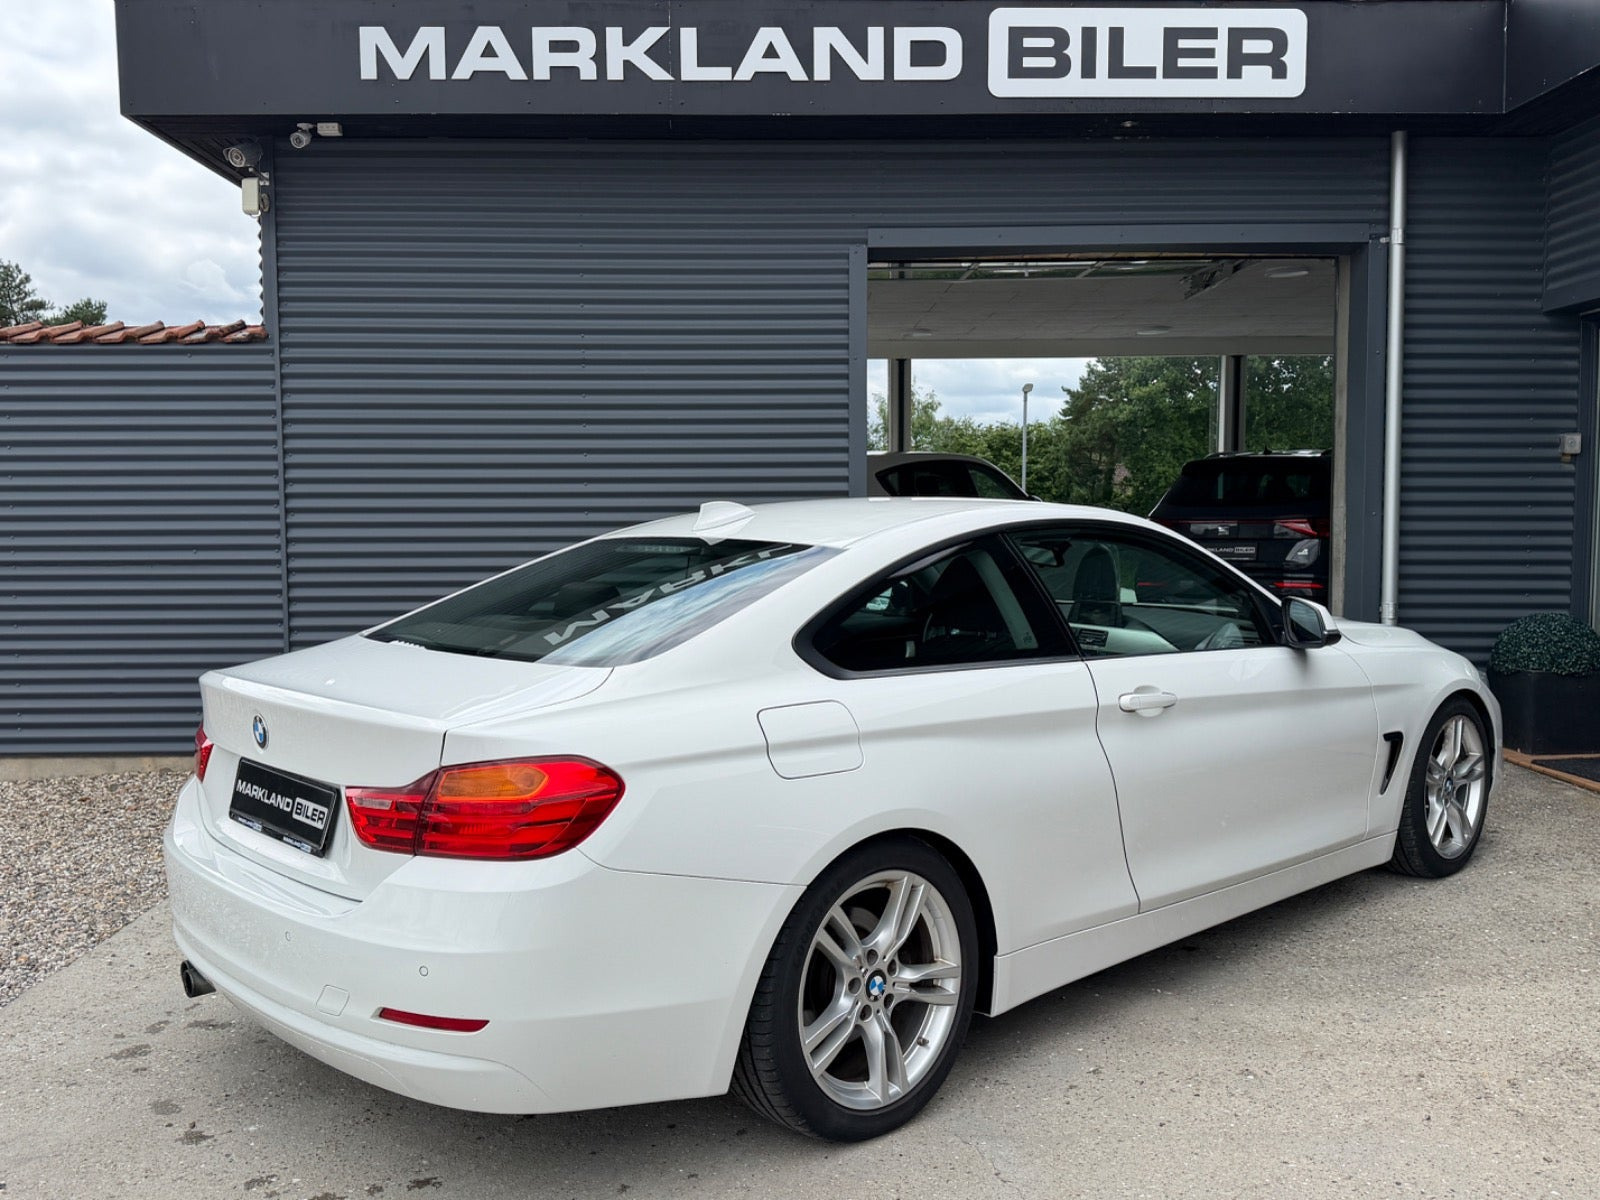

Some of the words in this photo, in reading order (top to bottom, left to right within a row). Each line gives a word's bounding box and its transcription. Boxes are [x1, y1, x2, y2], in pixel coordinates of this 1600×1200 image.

[359, 25, 963, 81] MARKLAND
[1007, 26, 1289, 80] BILER
[236, 779, 293, 812] MARKLAND
[294, 801, 326, 825] BILER
